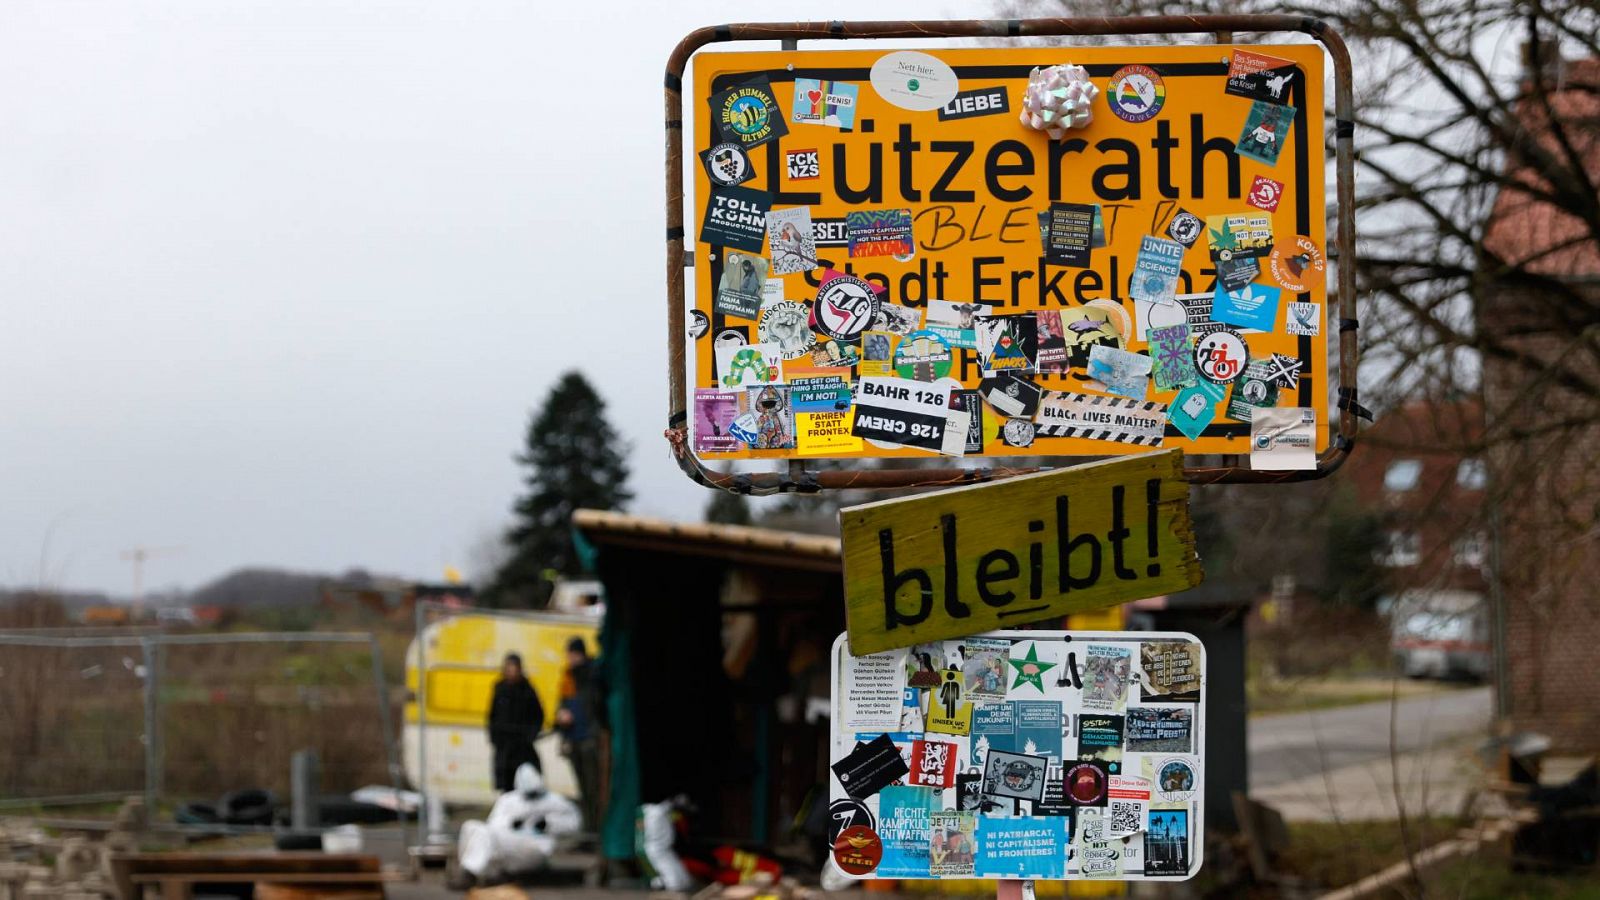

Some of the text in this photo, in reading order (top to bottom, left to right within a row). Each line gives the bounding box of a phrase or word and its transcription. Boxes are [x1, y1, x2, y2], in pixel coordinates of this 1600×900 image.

[897, 61, 915, 73] Nett
[1239, 80, 1257, 90] Krise!
[943, 93, 1003, 115] LIEBE
[741, 124, 771, 142] ULTRAS
[767, 113, 1241, 205] Lützerath
[787, 152, 819, 166] FCK
[788, 165, 819, 178] NZS
[715, 196, 761, 214] TOLL
[711, 208, 766, 228] KÜHN
[710, 218, 764, 234] PRODUCTIONS
[876, 226, 911, 234] CAPITALISM
[1143, 240, 1181, 257] UNITE
[1296, 238, 1323, 272] KOHLE?
[1139, 260, 1177, 275] SCIENCE
[719, 295, 741, 305] IVANA
[818, 277, 878, 318] ANTIFASCHISTISCHE AKTION
[718, 303, 756, 316] HOFFMANN
[758, 301, 796, 332] STUDENTS
[1152, 325, 1189, 342] SPREAD
[896, 353, 950, 364] HILDEN
[1276, 379, 1288, 388] 161
[800, 392, 837, 402] I'M NOT!
[863, 382, 944, 406] BAHR 126
[809, 412, 846, 422] FAHREN
[1083, 411, 1111, 424] LIVES
[1114, 414, 1158, 429] MATTER
[814, 420, 842, 429] STATT
[856, 415, 940, 439] 126 CREW
[808, 427, 850, 437] FRONTEX
[879, 477, 1160, 631] bleibt!
[932, 718, 953, 726] UNISEX
[1109, 778, 1119, 786] DB
[894, 808, 927, 819] RECHTE
[930, 817, 961, 827] JETZT!
